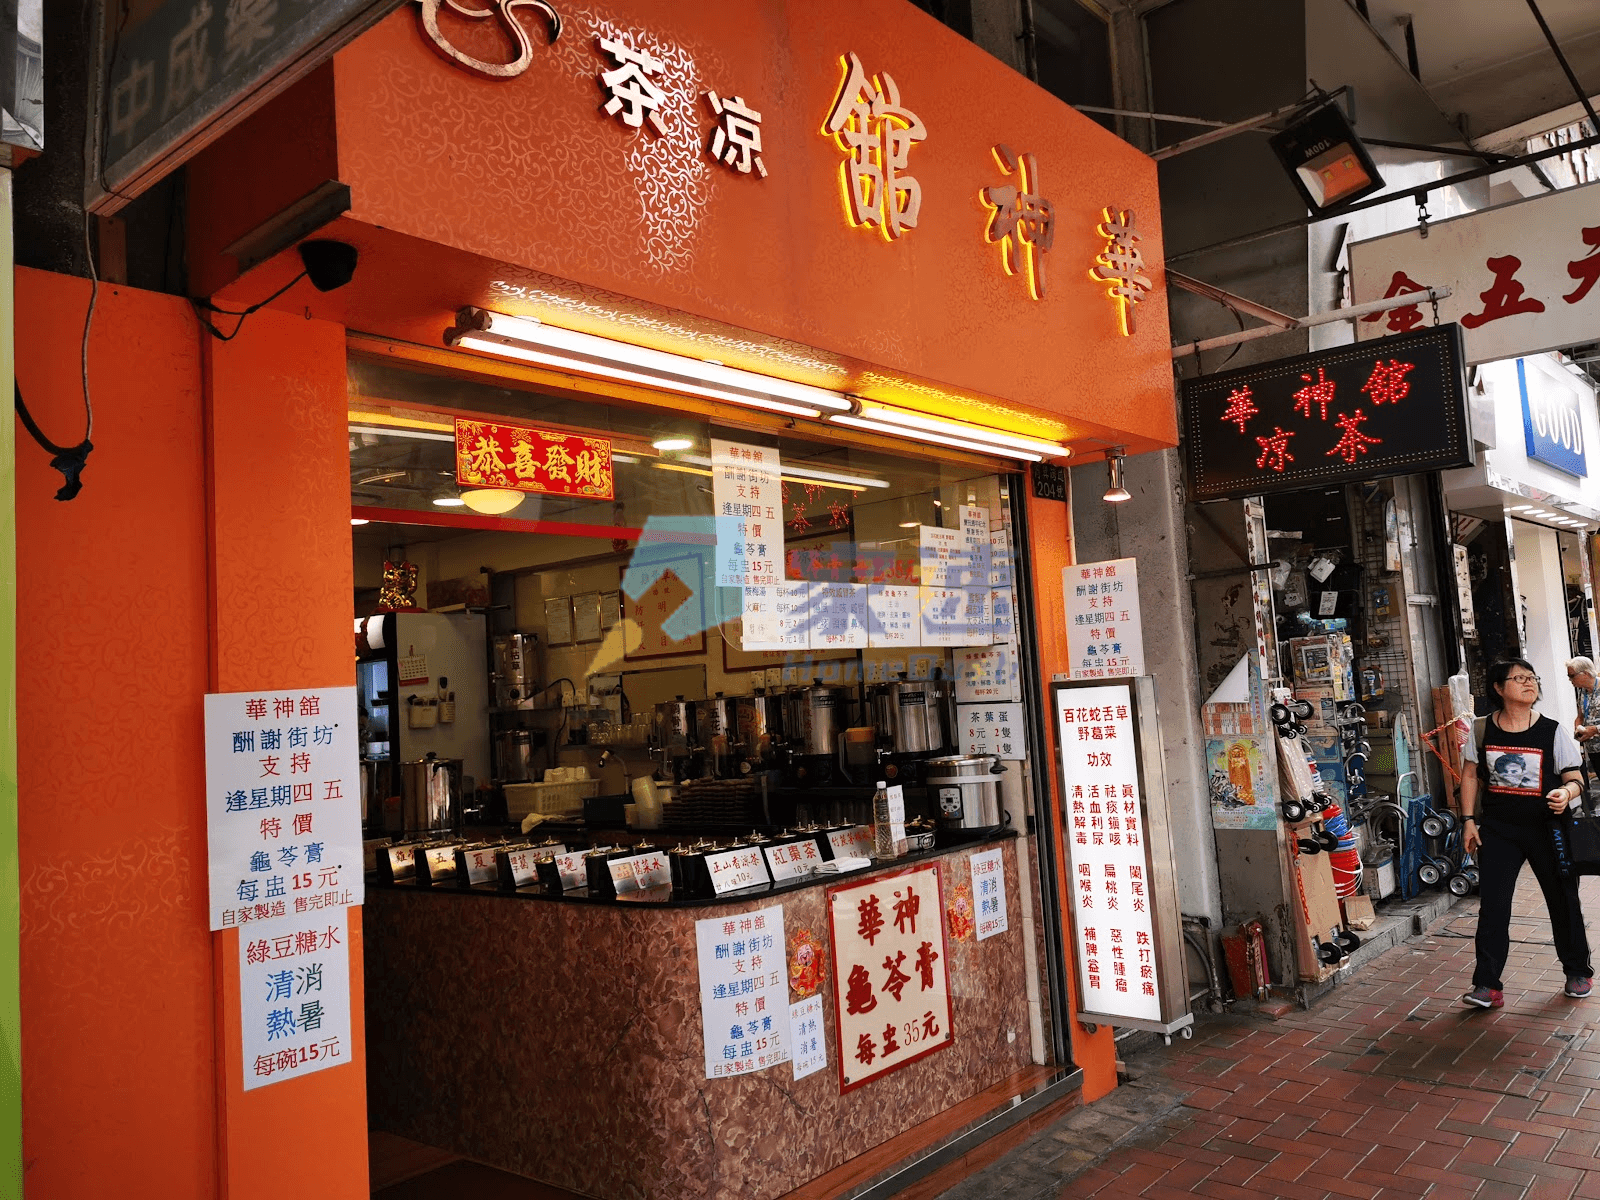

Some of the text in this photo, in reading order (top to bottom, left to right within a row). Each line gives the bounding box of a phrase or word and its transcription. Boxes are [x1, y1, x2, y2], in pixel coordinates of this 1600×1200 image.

[1304, 139, 1331, 157] 100W
[471, 434, 602, 486] 恭喜發財
[736, 484, 760, 499] 支持
[737, 523, 762, 538] 特價
[1080, 565, 1116, 580] 華神館
[1076, 581, 1123, 597] 酬謝街坊
[1088, 595, 1113, 609] 支持
[1090, 627, 1116, 640] 特價
[1087, 642, 1122, 656] 龜苓膏
[246, 695, 320, 721] 華神館
[970, 711, 1008, 723] 茶葉蛋
[1063, 704, 1129, 724] 百花蛇舌草
[232, 725, 333, 753] 酬謝街坊
[969, 727, 986, 739] 8元
[1077, 725, 1117, 742] 野葛菜
[259, 752, 311, 778] 支持
[1087, 752, 1112, 767] 功效
[225, 779, 343, 813] 逢星期四 五
[259, 812, 313, 840] 特價
[1071, 784, 1088, 845] 清熱解毒
[1087, 784, 1104, 846] 活血利尿
[250, 842, 324, 873] 龜苓膏
[773, 842, 818, 867] 紅棗茶
[793, 863, 810, 876] 10元
[1078, 863, 1094, 909] 咽喉炎
[1104, 864, 1119, 910] 扁桃炎
[222, 888, 353, 926] 自家製造 售完即止
[857, 885, 921, 947] 華神
[722, 915, 766, 937] 華神館
[246, 925, 341, 966] 綠豆糖水
[715, 934, 773, 960] 酬謝街坊
[1084, 926, 1101, 990] 補脾益胃
[732, 955, 762, 976] 支持
[1110, 928, 1128, 992] 惡性腫瘤
[713, 970, 780, 1000] 逢星期四 五
[735, 996, 766, 1018] 特價
[729, 1015, 772, 1041] 龜苓膏
[855, 1010, 940, 1066] 每盅35元
[253, 1036, 340, 1076] 每碗15元
[722, 1030, 780, 1061] 每盅15元
[713, 1048, 788, 1077] 自家製造 售完即止
